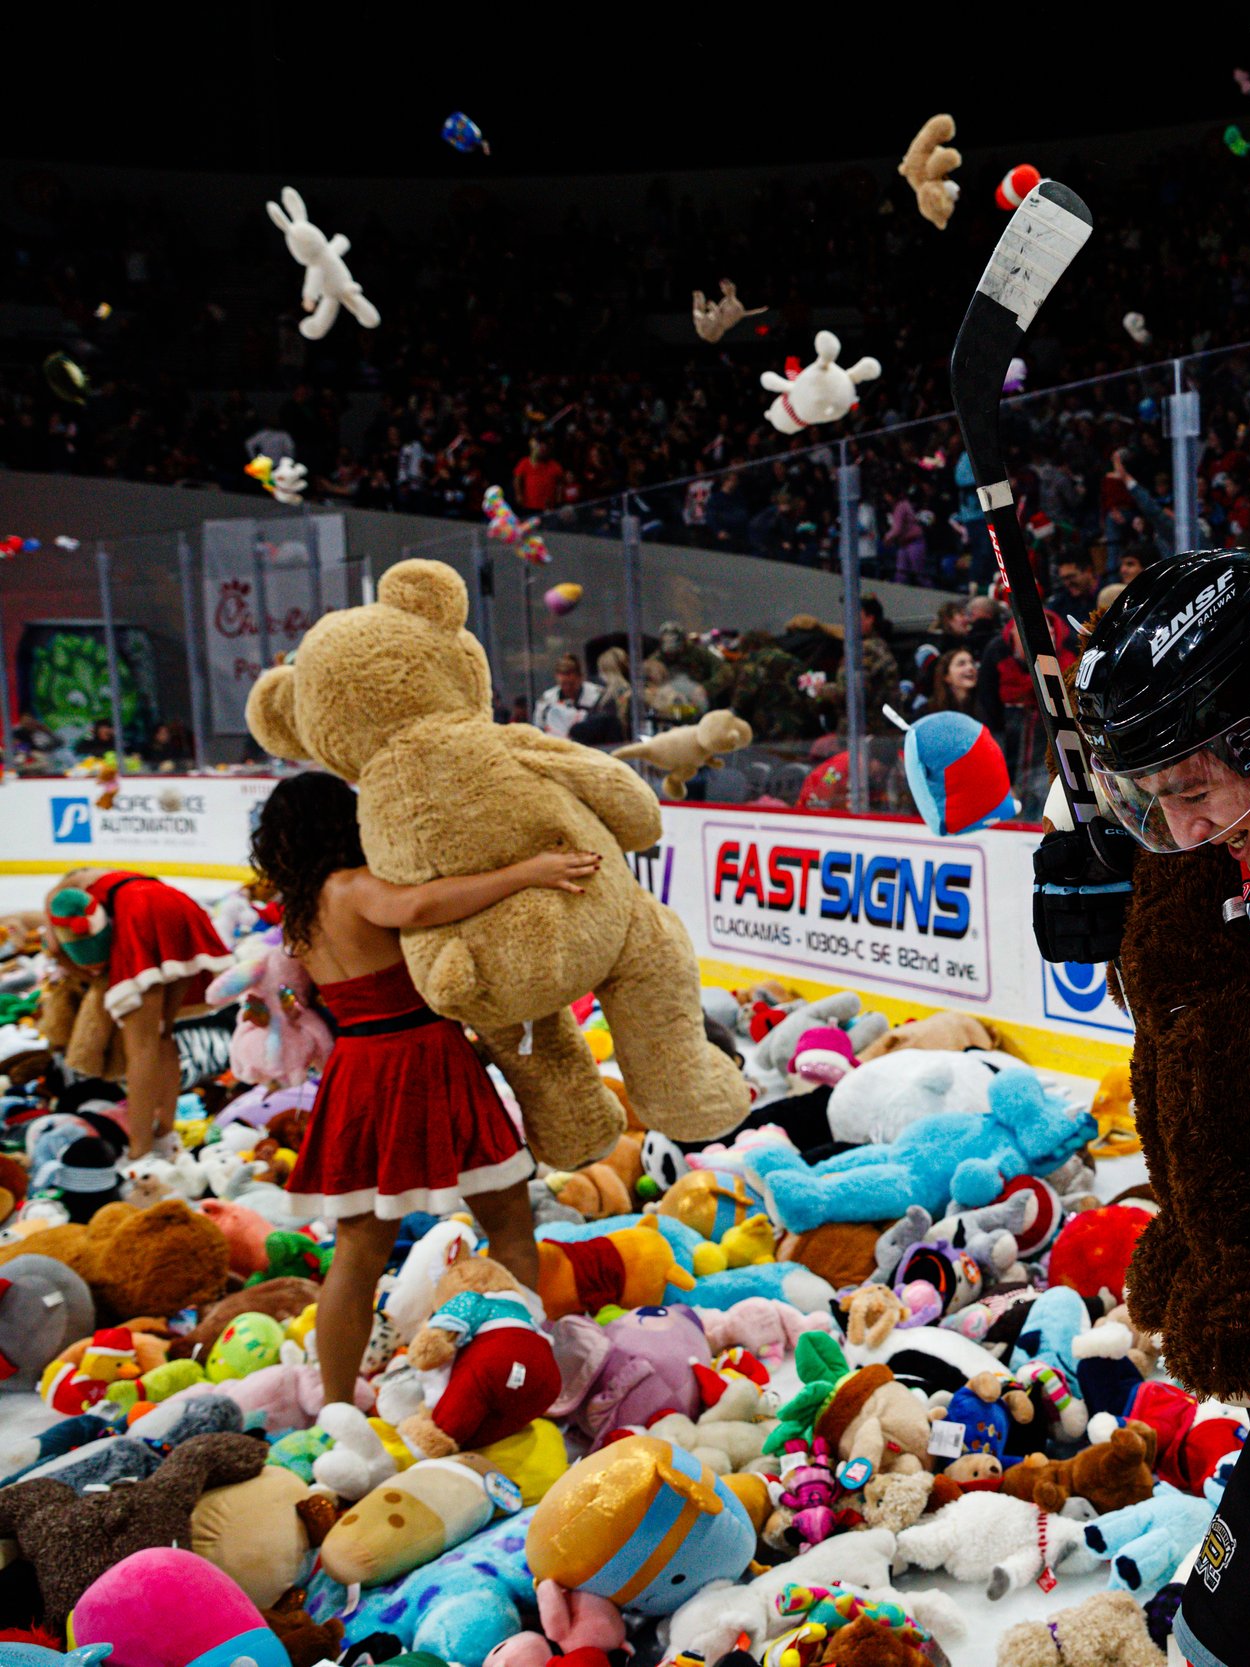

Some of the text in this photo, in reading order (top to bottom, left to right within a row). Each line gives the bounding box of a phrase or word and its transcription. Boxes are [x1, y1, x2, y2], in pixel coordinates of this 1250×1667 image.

[1150, 566, 1235, 657] BNSF
[1197, 588, 1237, 627] RAILWAY
[1084, 733, 1106, 746] CM
[100, 816, 197, 833] AUTOMATION
[714, 841, 972, 939] FASTSIGNS
[713, 915, 791, 946] CLACKAMAS
[806, 931, 865, 960] 10309-C
[870, 942, 892, 965] SE
[898, 946, 939, 974] 82nd
[946, 960, 978, 981] ave.
